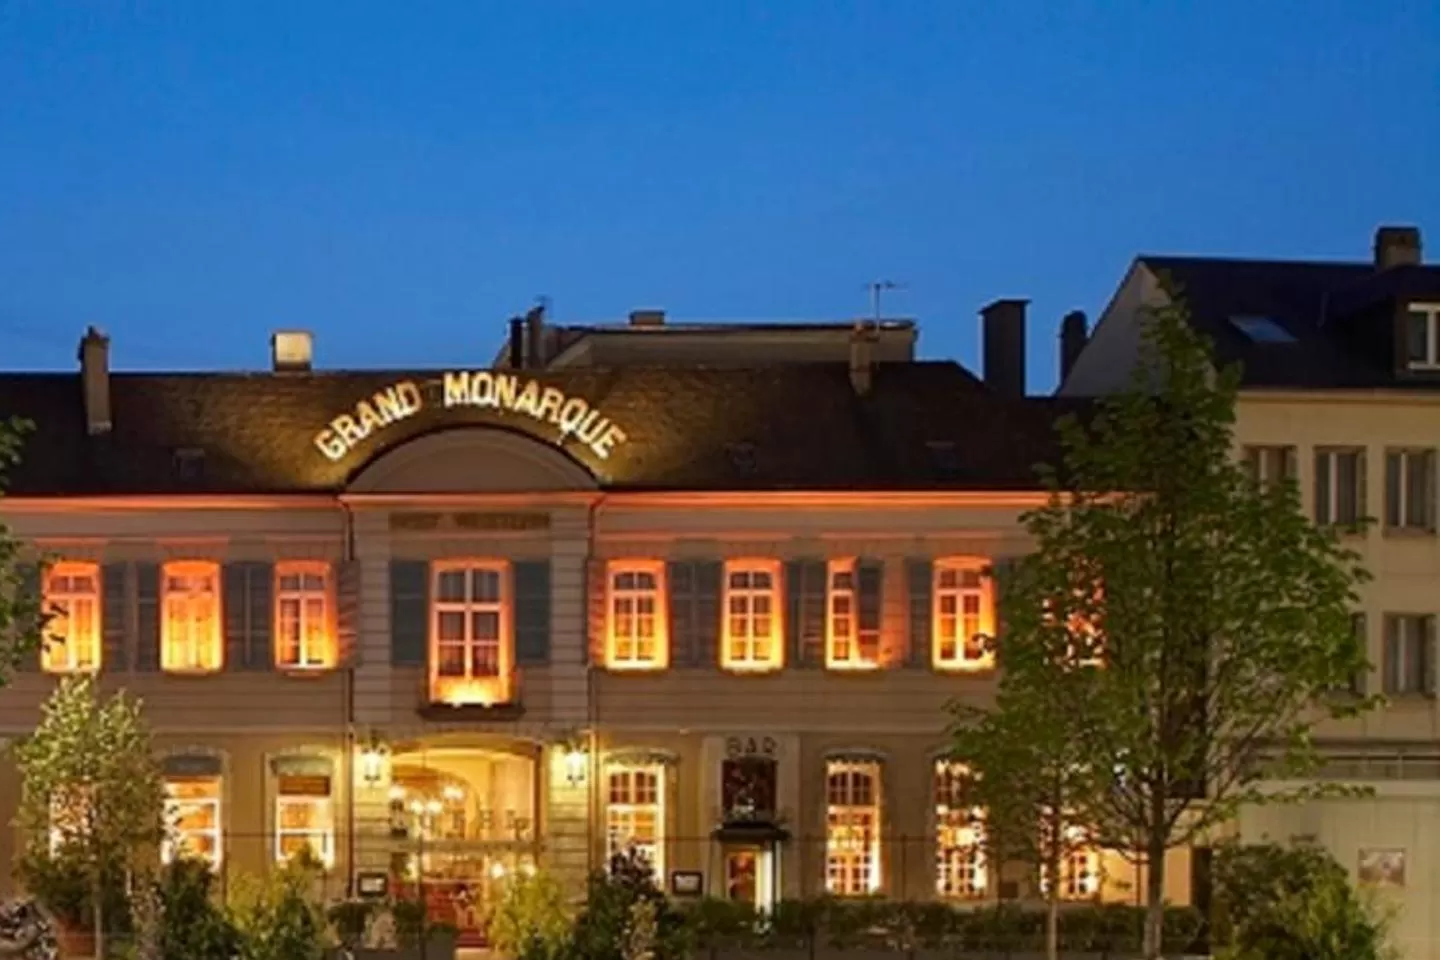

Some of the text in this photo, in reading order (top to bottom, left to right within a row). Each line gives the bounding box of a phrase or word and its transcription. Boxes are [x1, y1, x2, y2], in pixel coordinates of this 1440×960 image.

[314, 371, 627, 461] GRAND MONARQUE
[726, 736, 778, 755] BAR
